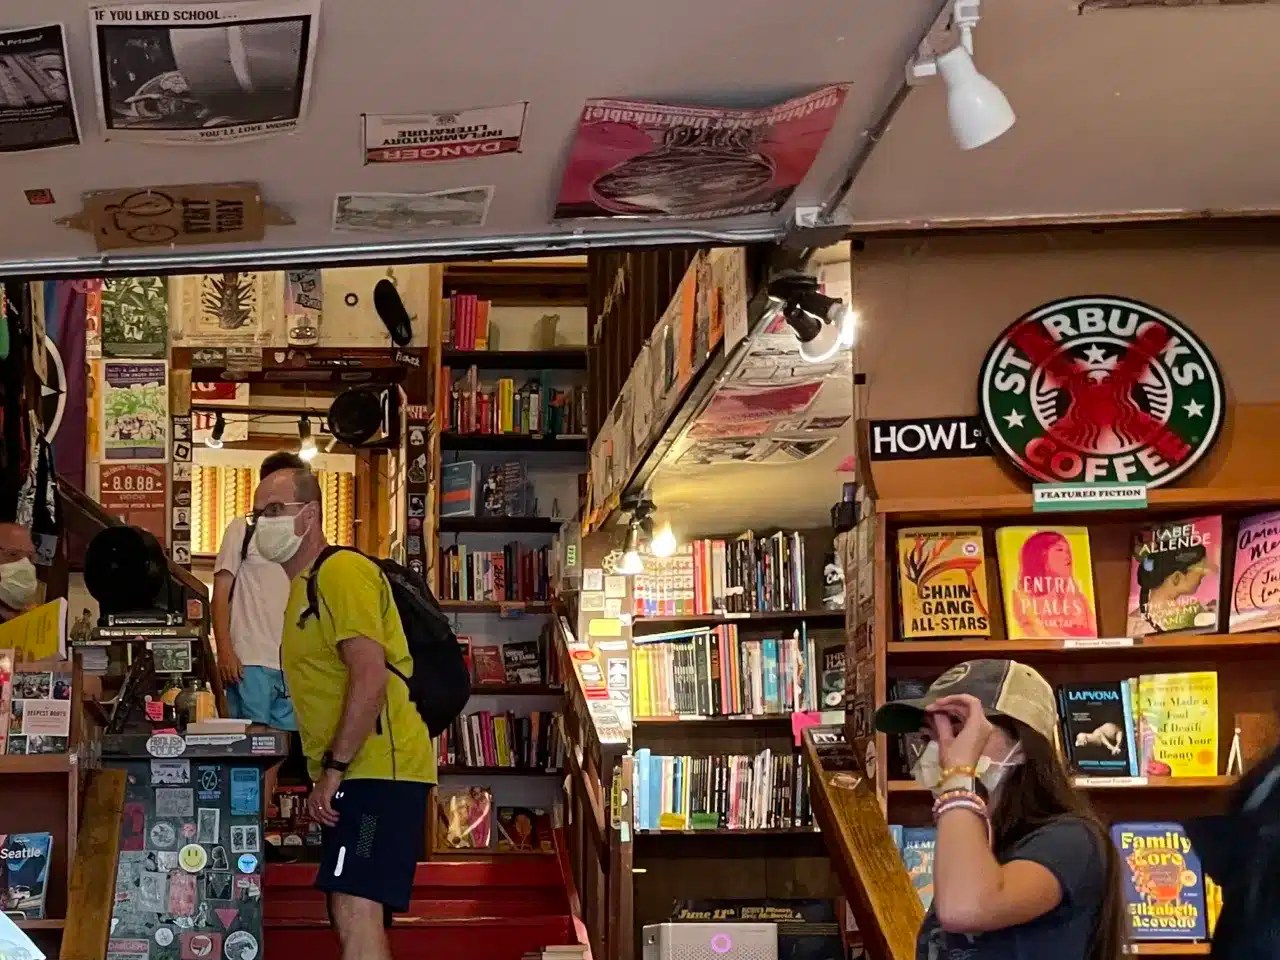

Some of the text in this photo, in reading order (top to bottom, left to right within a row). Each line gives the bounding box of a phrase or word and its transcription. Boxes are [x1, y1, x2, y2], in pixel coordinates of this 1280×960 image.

[95, 10, 107, 21] IF
[109, 10, 133, 21] YOU
[135, 9, 170, 21] LIKED
[238, 124, 262, 134] LOVE
[397, 125, 488, 138] LITERATURE
[382, 129, 503, 146] INFLAMMATORY
[383, 142, 501, 160] DANGER
[874, 422, 976, 454] HOWL
[1040, 488, 1142, 499] FEATURED FICTION
[1139, 532, 1212, 556] ALLENDE
[922, 600, 975, 616] GANG
[911, 617, 988, 633] ALL-STARS
[1069, 690, 1119, 701] LAPVONA
[1121, 831, 1192, 853] Family
[0, 846, 42, 860] Seattle
[678, 908, 711, 919] June
[1129, 901, 1198, 918] Elizabeth
